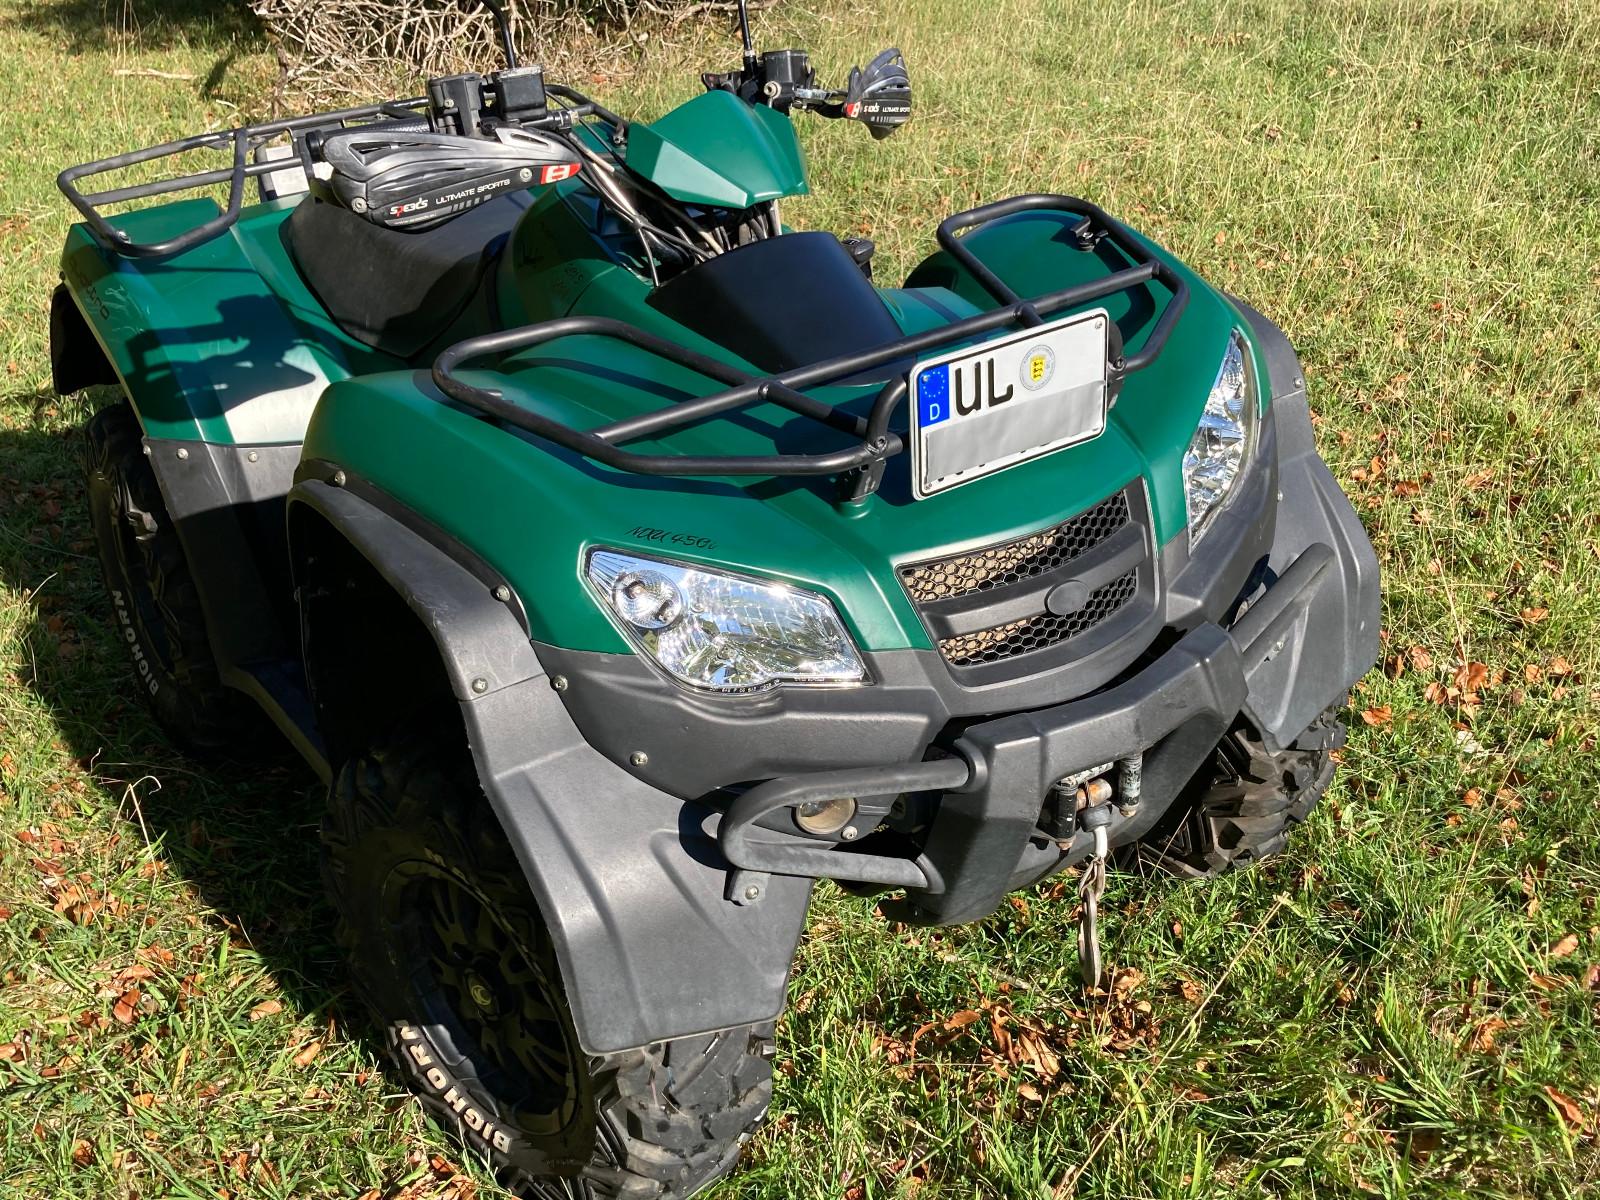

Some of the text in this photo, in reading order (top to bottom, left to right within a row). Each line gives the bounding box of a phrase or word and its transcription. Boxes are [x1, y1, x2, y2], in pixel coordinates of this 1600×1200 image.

[435, 187, 475, 205] ULTIMATE
[477, 178, 511, 194] SPORTS
[929, 403, 941, 421] D
[954, 357, 1014, 416] UL
[112, 590, 159, 696] BIGHORN
[394, 1019, 513, 1154] BIGHORN
